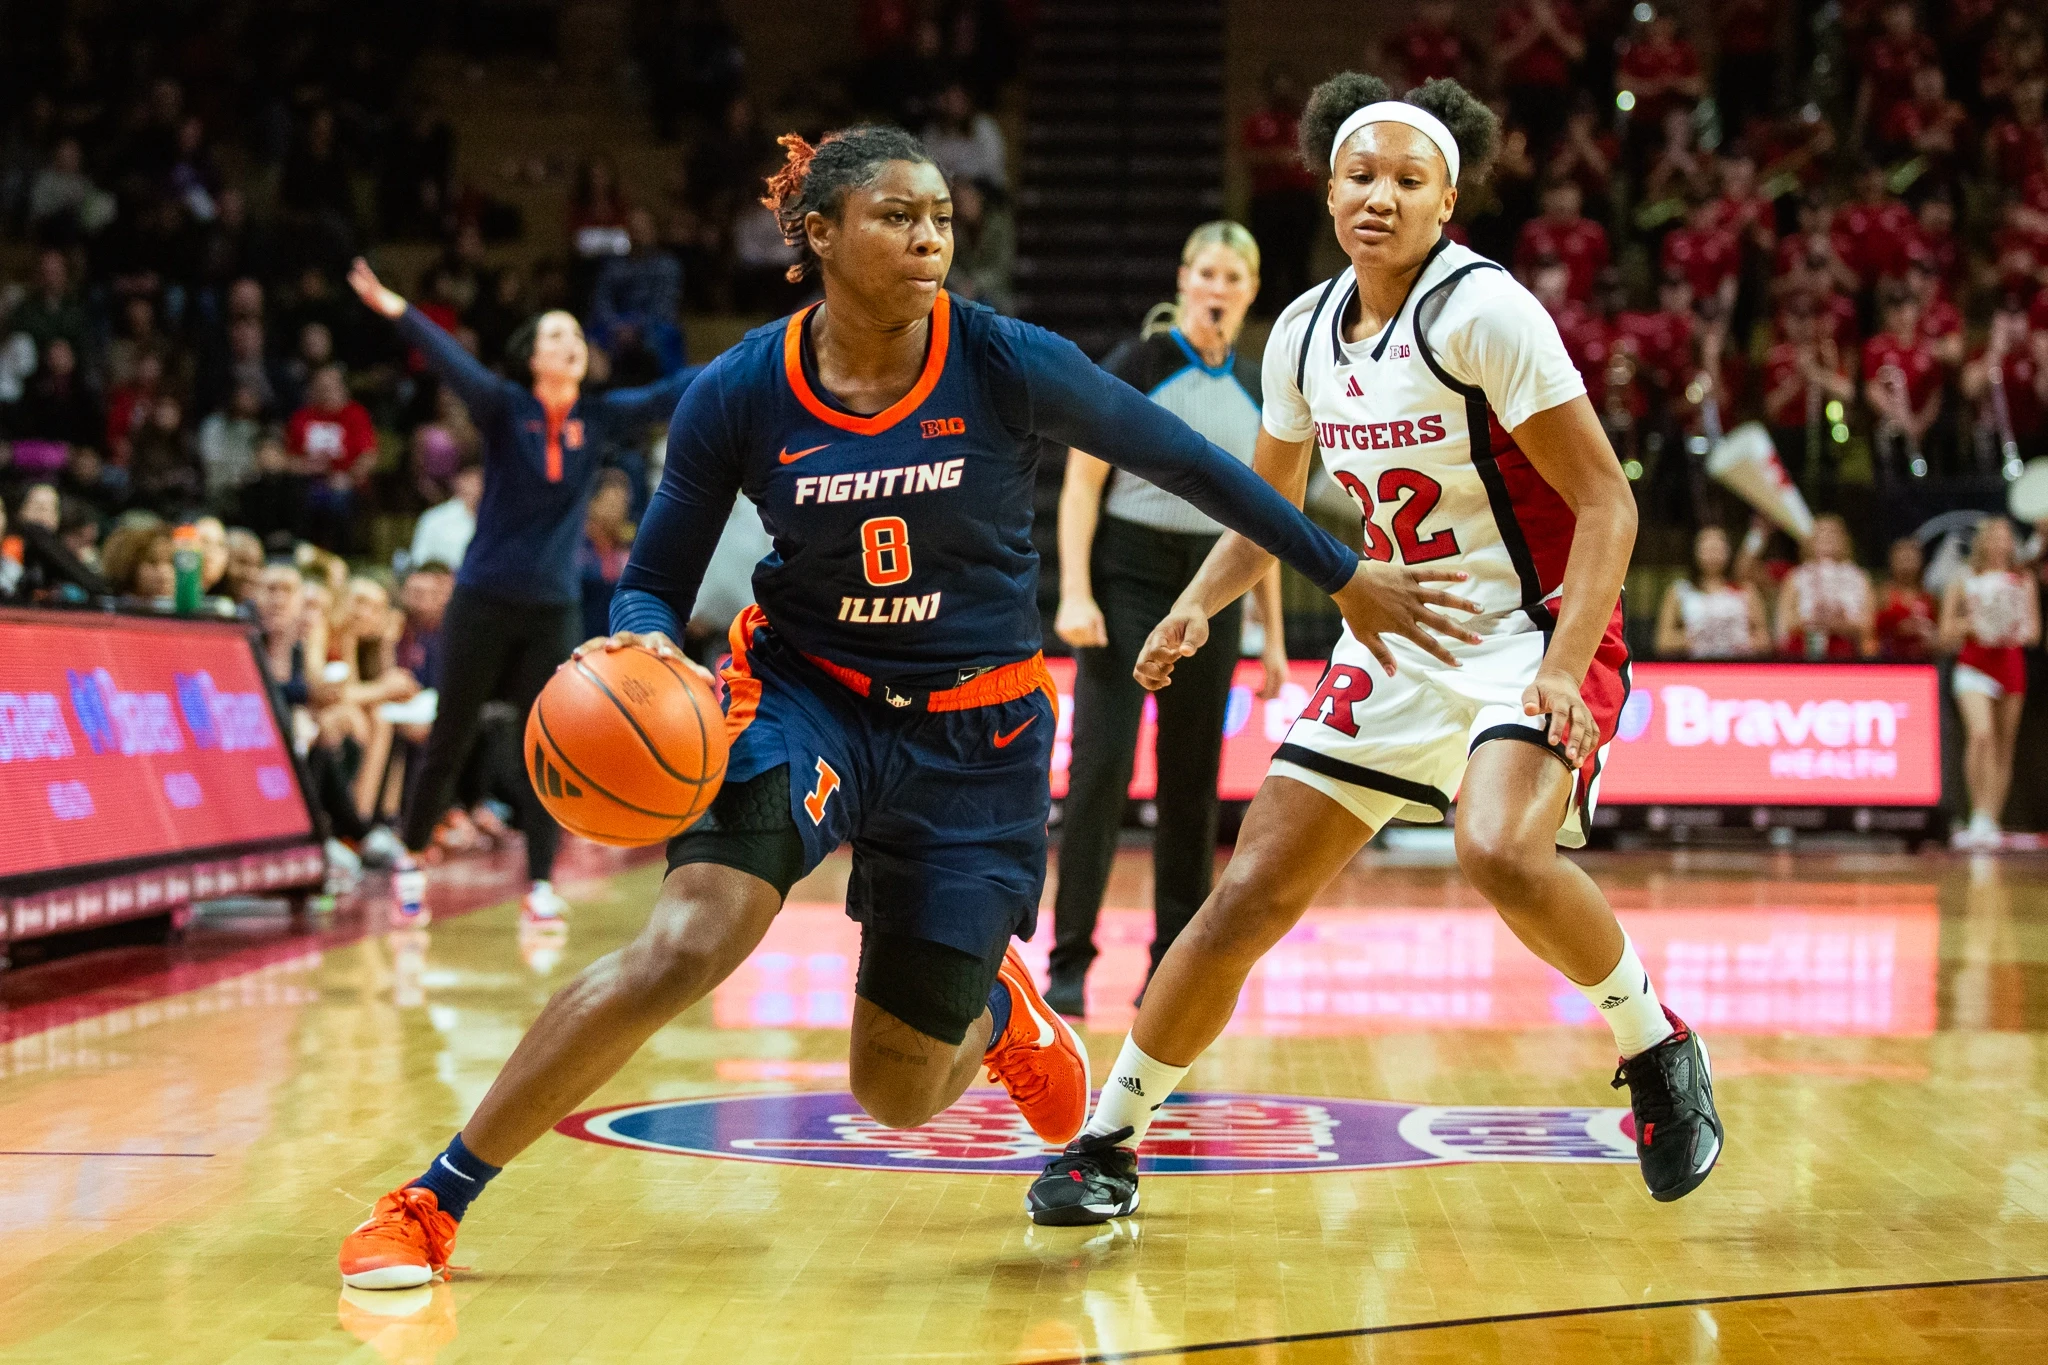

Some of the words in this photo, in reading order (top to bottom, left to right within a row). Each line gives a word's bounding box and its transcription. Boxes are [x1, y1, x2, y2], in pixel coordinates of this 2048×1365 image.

[1314, 414, 1446, 450] RUTGERS
[795, 458, 965, 505] FIGHTING
[860, 516, 913, 587] 8
[837, 592, 941, 623] ILLINI
[1300, 663, 1373, 739] R
[1661, 684, 1897, 747] Braven
[1118, 1077, 1145, 1097] adidas
